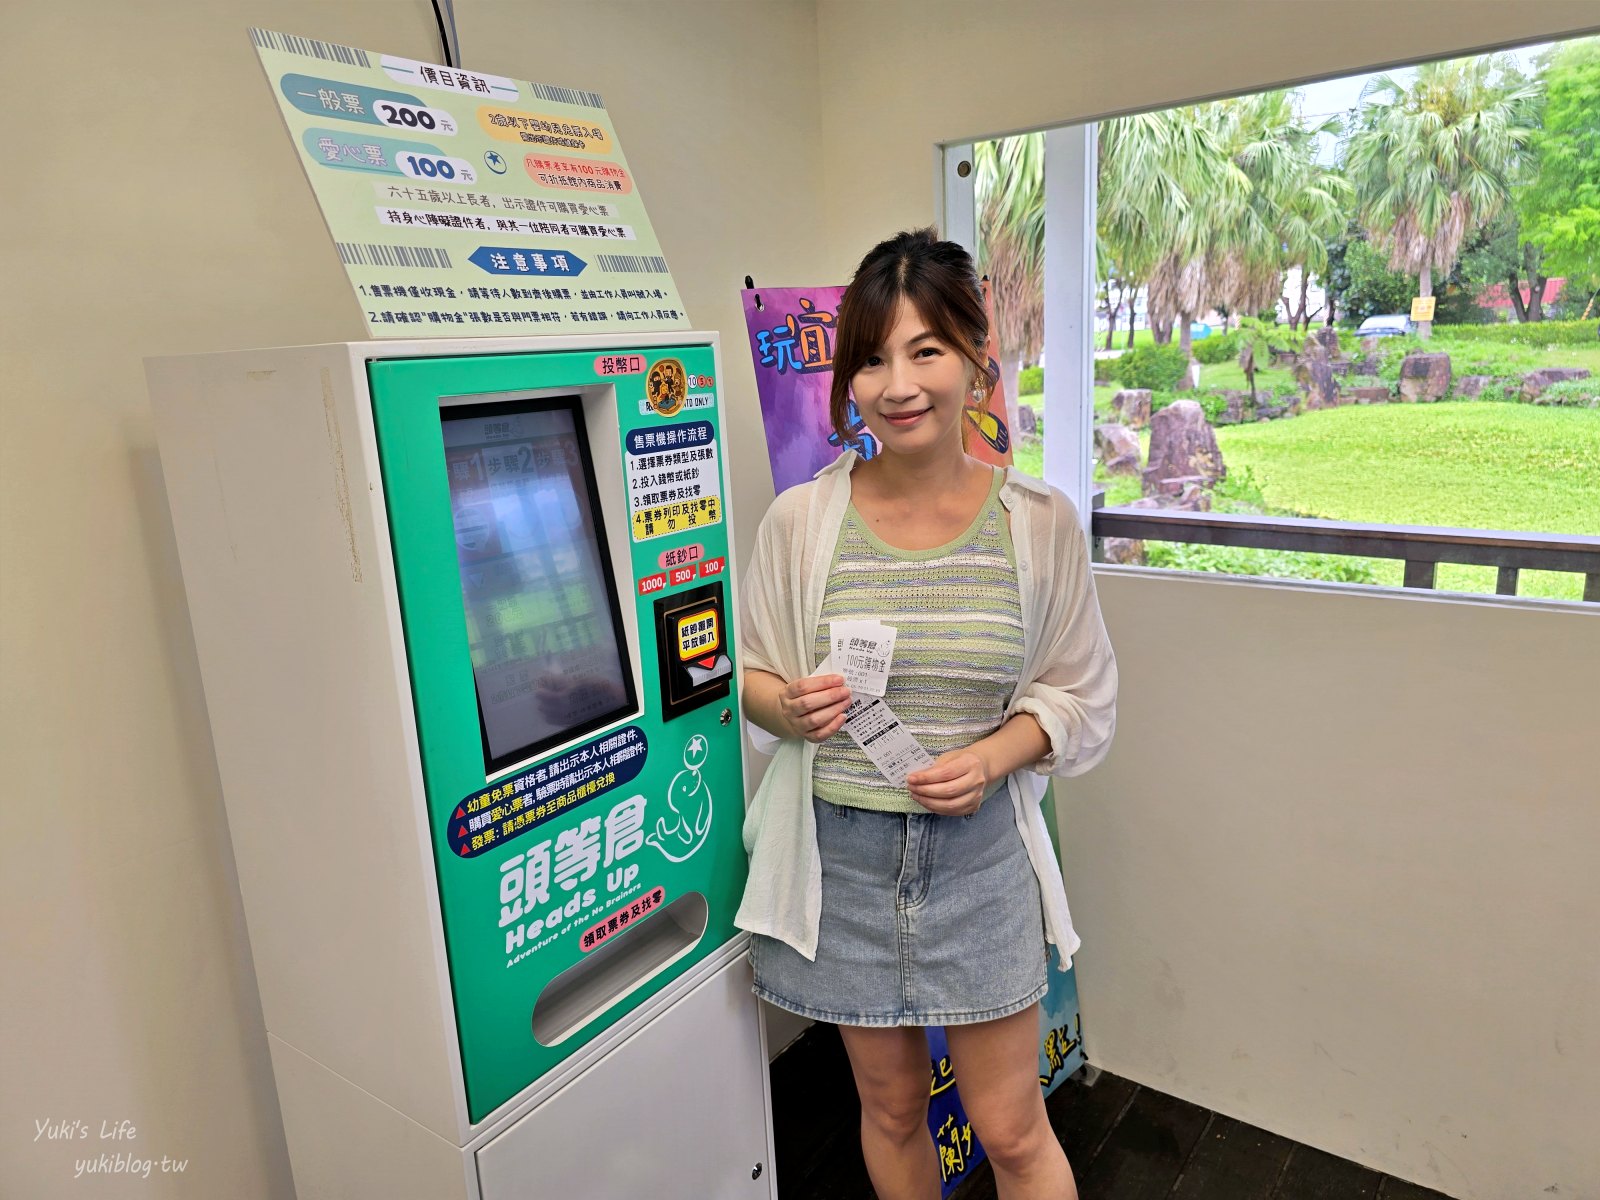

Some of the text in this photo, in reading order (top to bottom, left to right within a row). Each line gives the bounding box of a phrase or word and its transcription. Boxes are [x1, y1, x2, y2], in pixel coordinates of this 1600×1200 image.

[420, 65, 491, 94] 價目資訊
[297, 87, 367, 115] 一般票
[318, 137, 388, 167] 愛心票
[538, 173, 623, 191] 可折抵館內商品消費
[490, 252, 570, 272] 注意事項
[755, 297, 848, 375] 玩宜
[602, 357, 640, 374] 投幣口
[634, 426, 708, 450] 售票機操作流程
[488, 446, 535, 476] 步驟2
[665, 546, 698, 567] 紙鈔口
[642, 561, 719, 592] 1000 500 100
[498, 794, 648, 928] 頭等倉
[505, 863, 640, 954] Heads Up
[583, 889, 663, 949] 領取票券及找零
[506, 882, 642, 969] Adventure of the No Brainers
